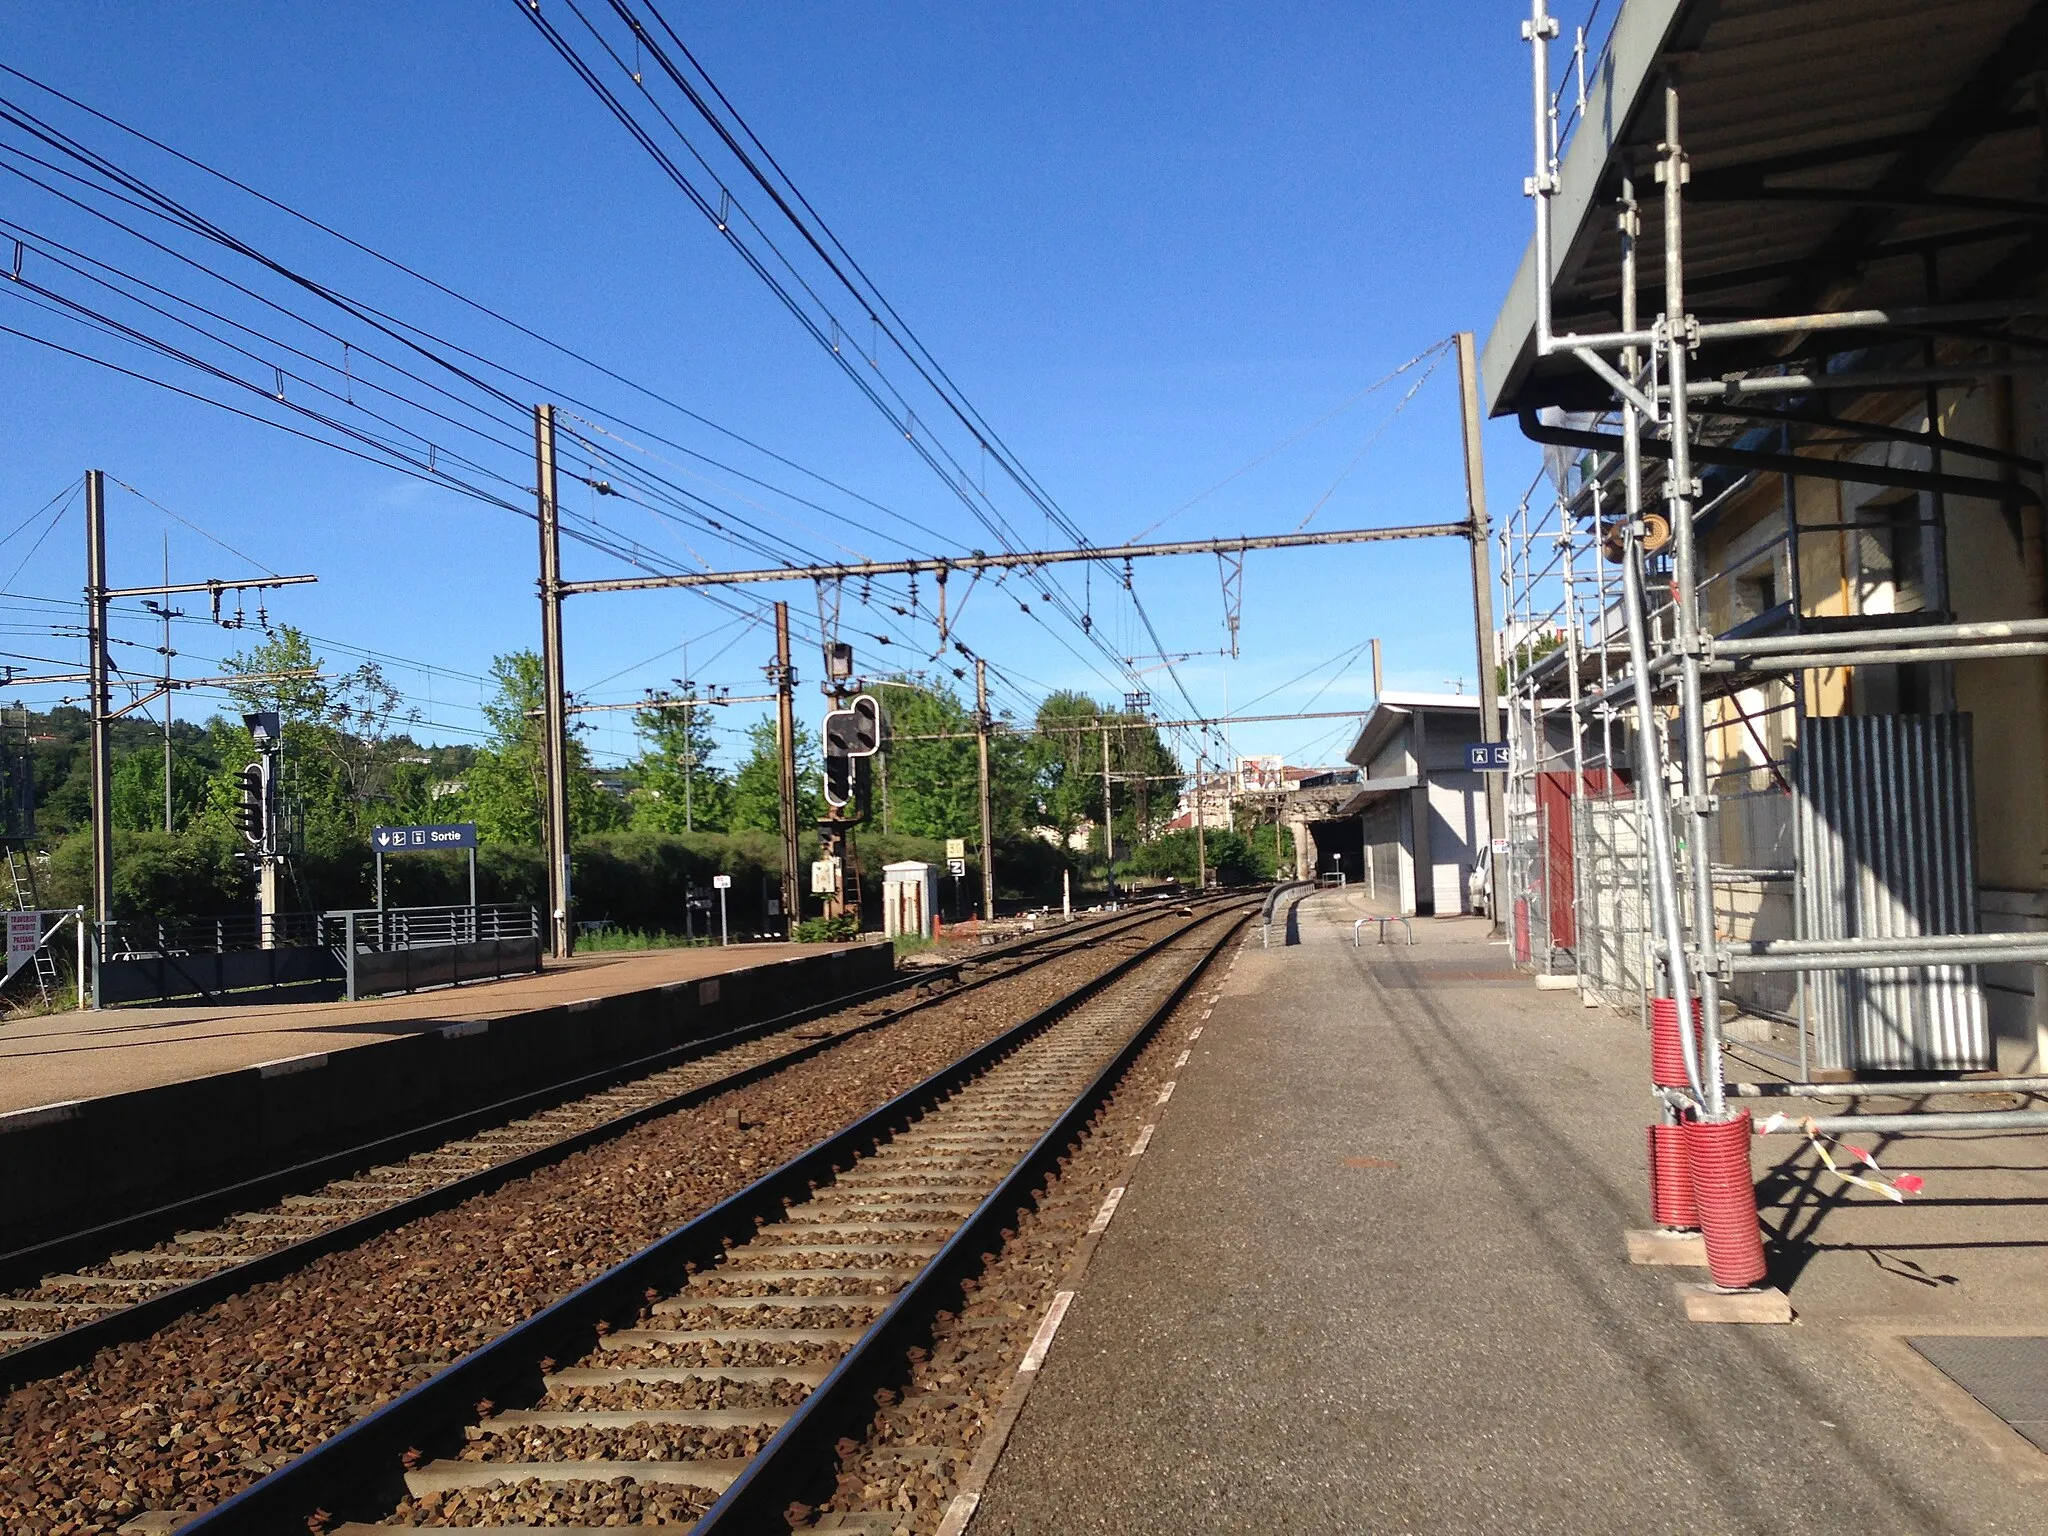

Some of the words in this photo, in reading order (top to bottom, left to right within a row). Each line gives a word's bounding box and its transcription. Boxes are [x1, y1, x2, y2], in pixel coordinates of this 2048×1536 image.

[430, 830, 461, 842] Sortie
[950, 861, 962, 873] Z
[13, 935, 34, 943] PASSAGE
